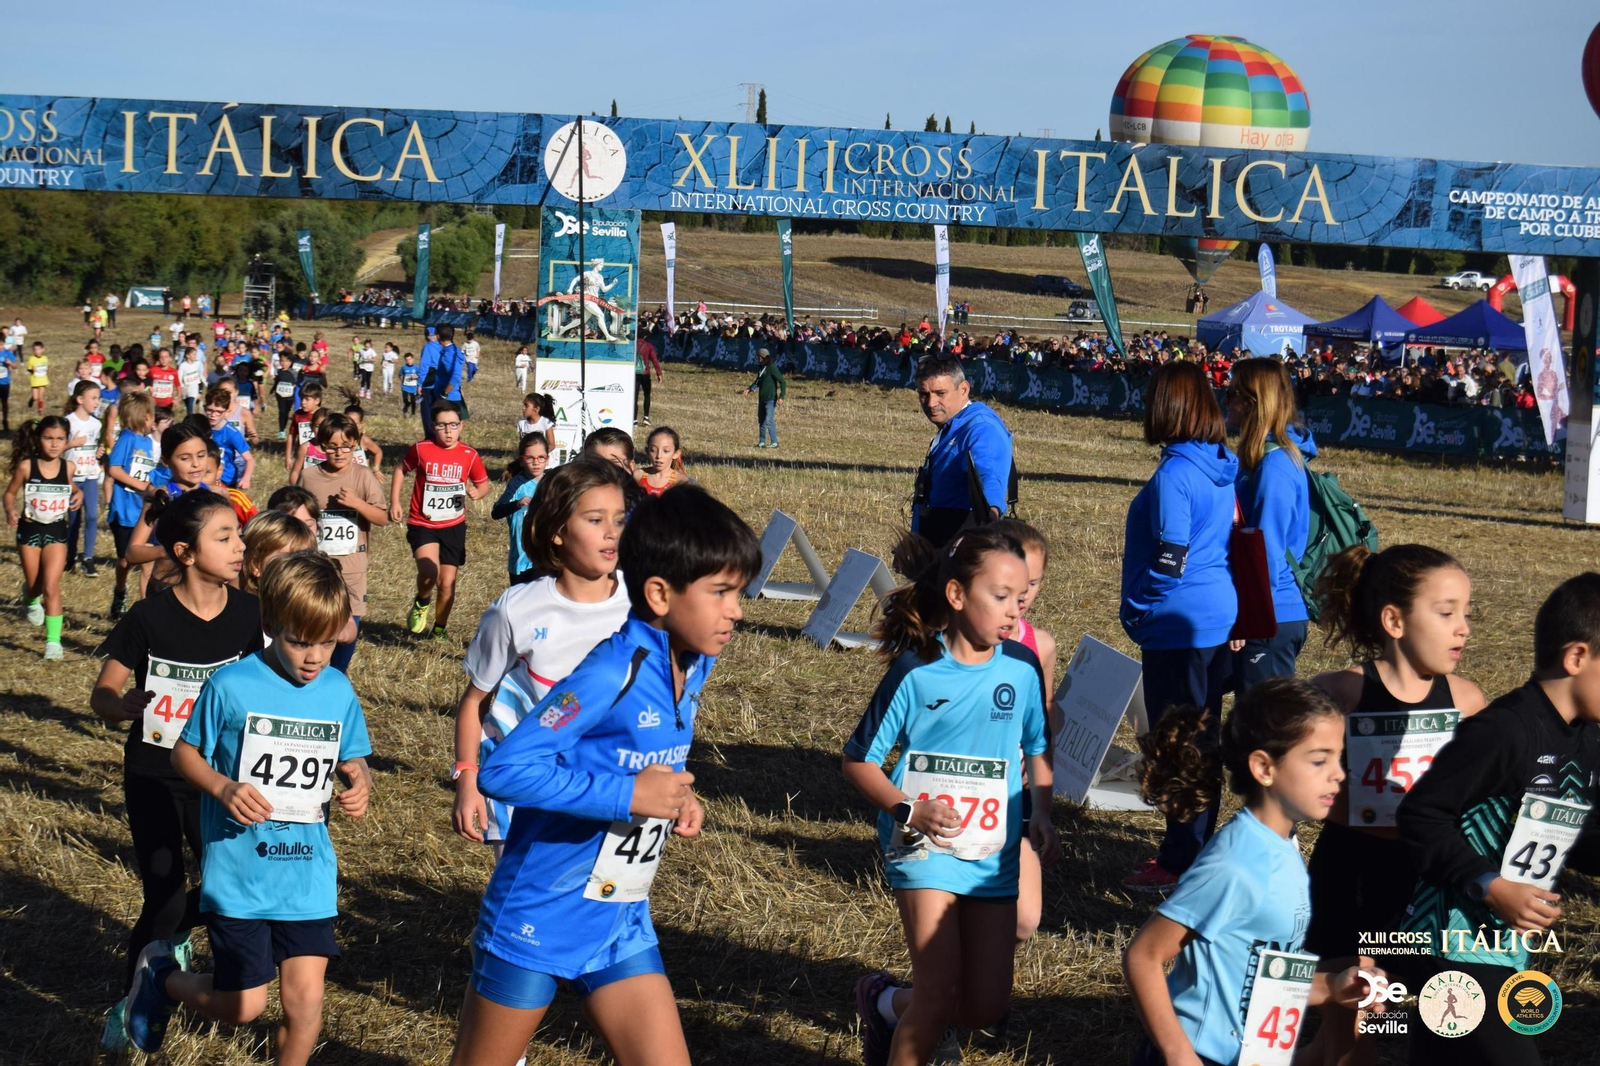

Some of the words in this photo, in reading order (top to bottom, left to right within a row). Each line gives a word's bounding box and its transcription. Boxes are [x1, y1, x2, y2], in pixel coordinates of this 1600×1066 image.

[119, 102, 443, 183] ITÁLICA
[1240, 127, 1270, 149] Hay
[671, 133, 840, 194] XLIII
[844, 142, 973, 179] CROSS
[844, 178, 1019, 203] INTERNACIONAL
[1031, 142, 1340, 226] ITÁLICA
[670, 191, 828, 215] INTERNATIONAL
[832, 199, 891, 217] CROSS
[895, 202, 987, 222] COUNTRY
[1449, 190, 1559, 208] CAMPEONATO
[1562, 195, 1582, 209] DE
[1485, 206, 1505, 219] DE
[1508, 207, 1566, 222] CAMPO
[1569, 211, 1581, 223] A
[592, 226, 627, 237] Sevilla
[1519, 222, 1550, 236] POR
[1553, 223, 1600, 239] CLUBE
[427, 495, 463, 510] 4205
[153, 695, 195, 723] 44
[279, 723, 326, 738] ITÁLICA
[1384, 716, 1438, 732] ITÁLICA
[1055, 714, 1104, 773] ITÁLICA
[934, 758, 986, 775] ITÁLICA
[1537, 755, 1555, 764] 42K
[250, 753, 334, 791] 4297
[1256, 1006, 1300, 1051] 43
